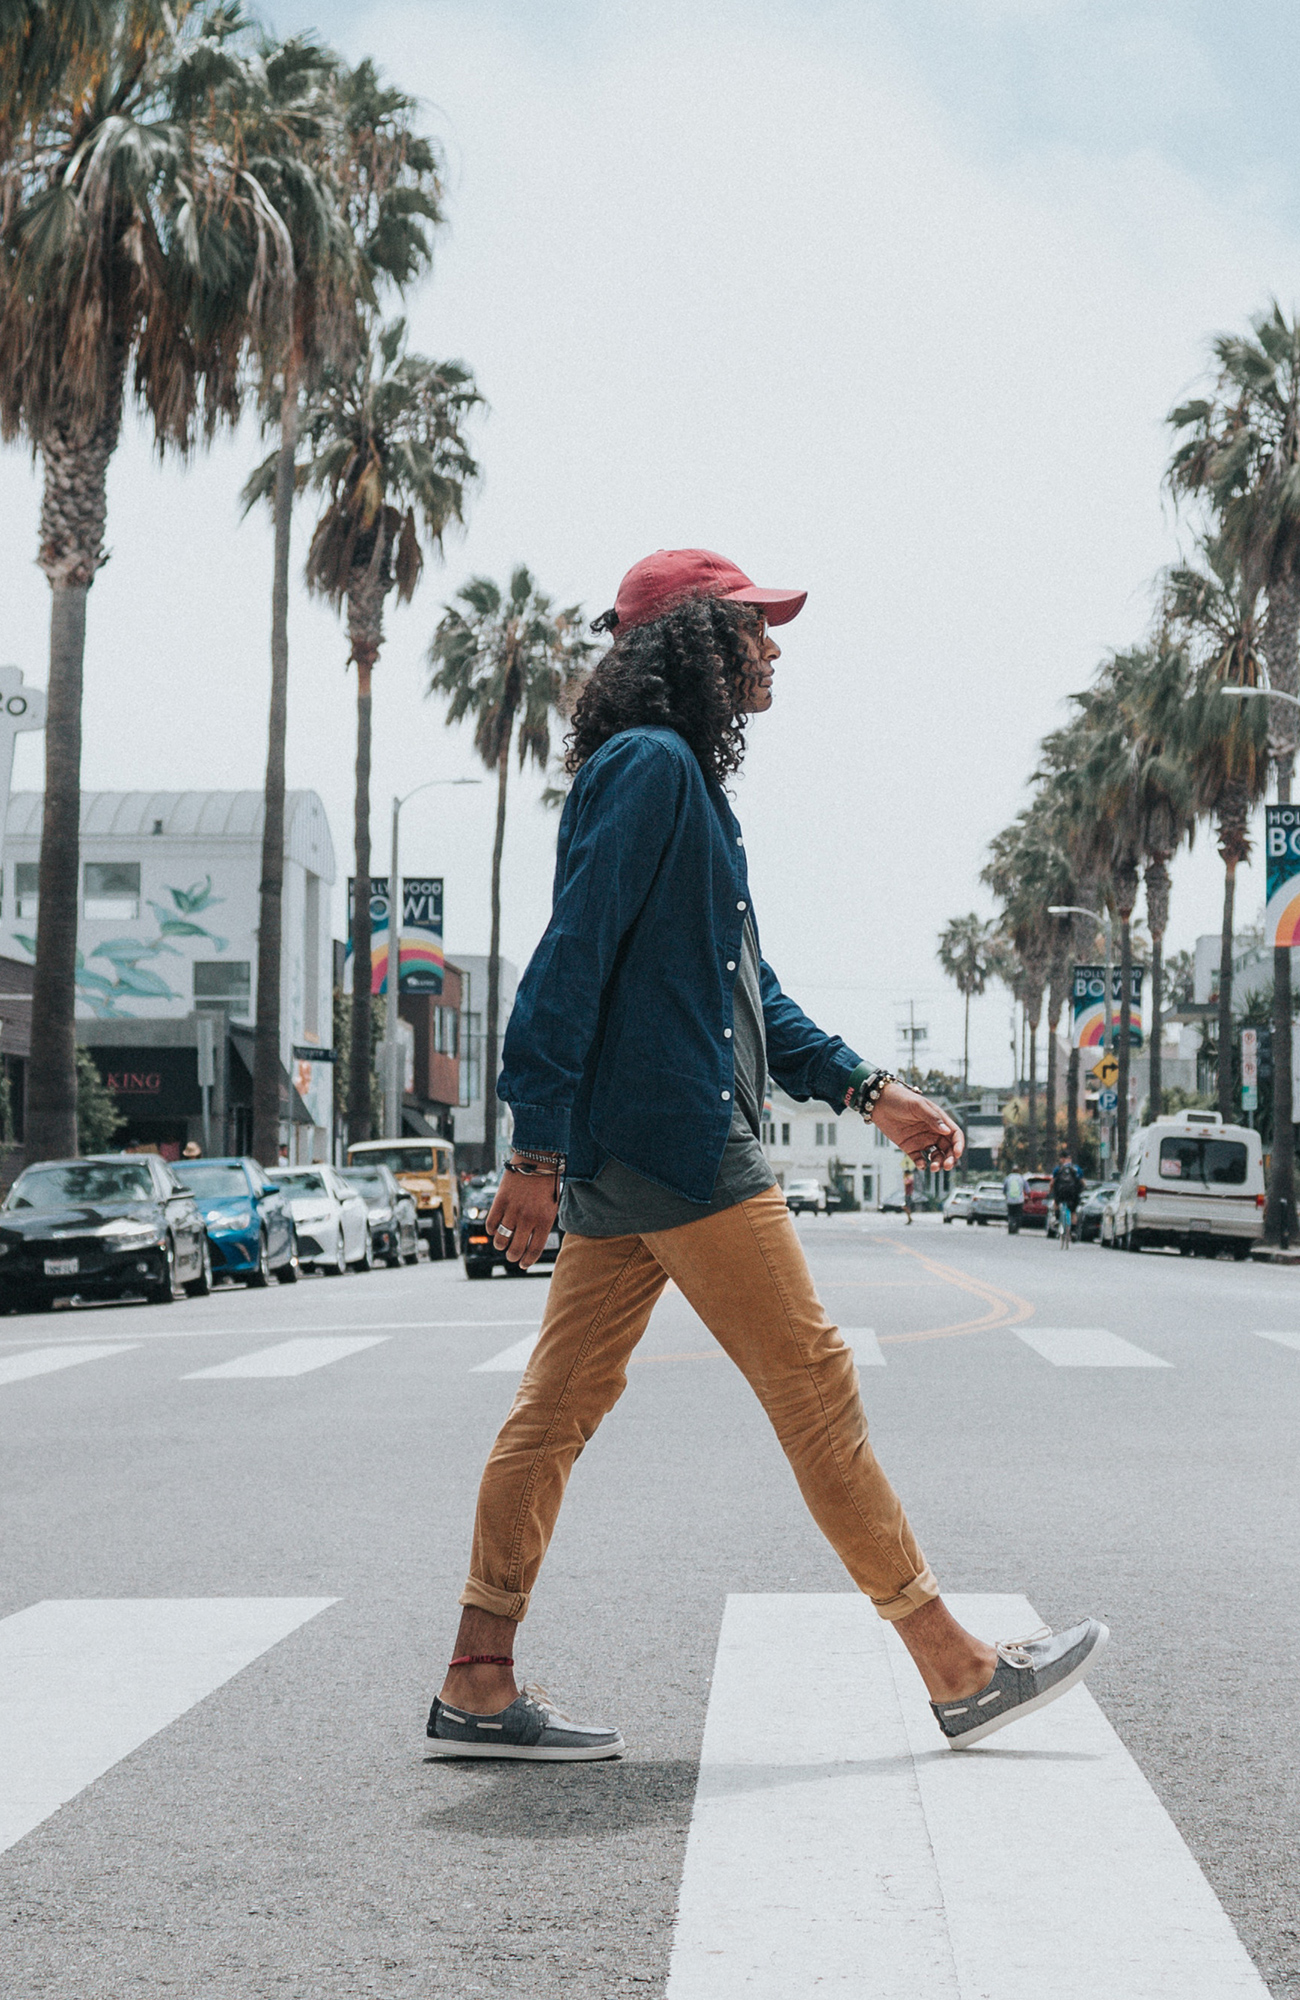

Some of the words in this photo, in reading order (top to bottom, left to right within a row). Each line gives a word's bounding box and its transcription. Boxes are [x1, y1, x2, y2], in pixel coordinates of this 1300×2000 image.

[0, 692, 27, 716] O
[350, 882, 442, 896] LLYOOD
[350, 895, 441, 921] OWL
[107, 1072, 161, 1089] KING
[1103, 1093, 1116, 1109] P
